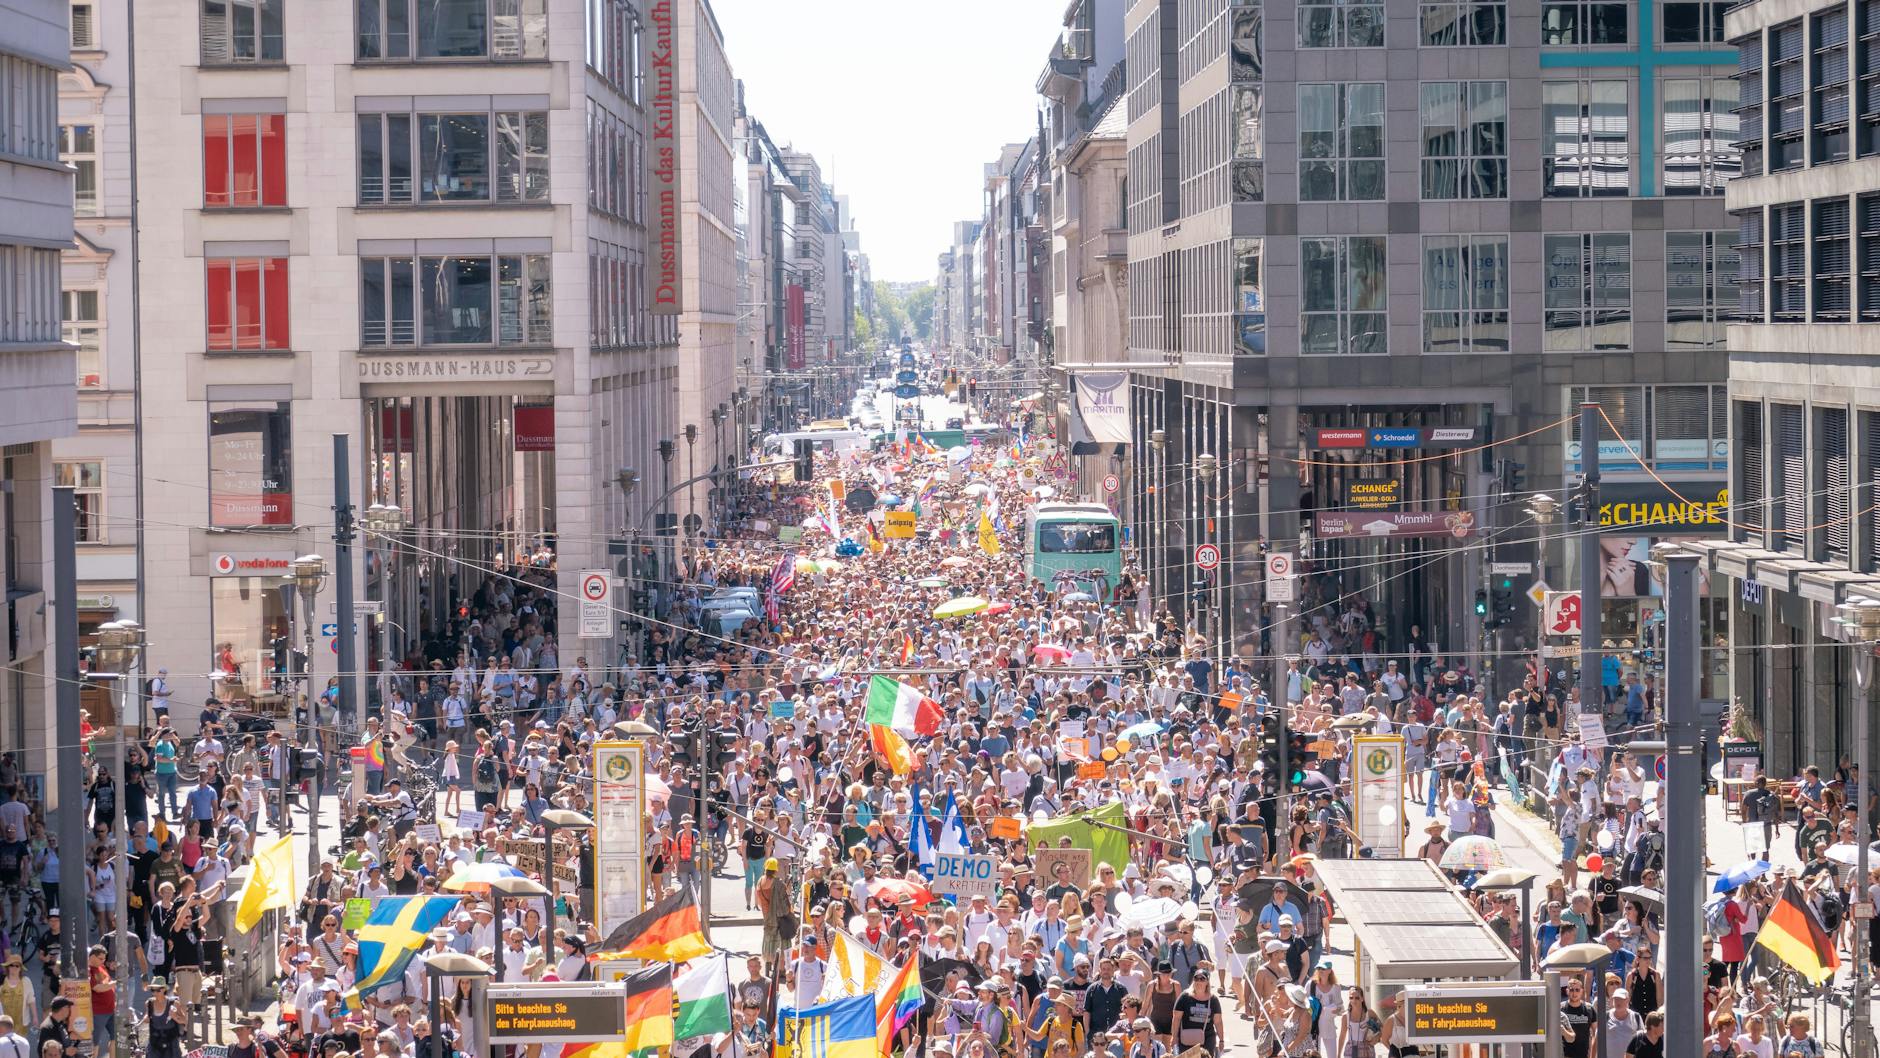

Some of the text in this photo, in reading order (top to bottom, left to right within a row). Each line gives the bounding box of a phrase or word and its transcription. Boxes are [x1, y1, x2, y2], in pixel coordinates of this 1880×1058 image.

[654, 147, 674, 183] das
[656, 190, 676, 305] Dussmann
[359, 360, 517, 377] DUSSMANN-HAUS
[1321, 432, 1363, 440] westermann
[1383, 434, 1416, 442] Schroedel
[1435, 431, 1470, 439] Diesterweg
[263, 480, 278, 489] Uhr
[1106, 479, 1116, 488] 30
[888, 519, 913, 528] Leipzig
[1320, 518, 1344, 526] berlin
[1394, 514, 1433, 525] Mmmh!
[1320, 526, 1344, 534] tapas
[1200, 551, 1215, 563] 30
[237, 559, 289, 569] vodafone
[937, 856, 992, 879] DEMO
[495, 1002, 568, 1015] Bitte beachten Sie
[1415, 1002, 1488, 1015] Bitte beachten Sie
[496, 1017, 576, 1030] den Fahrplanaushang
[1415, 1017, 1496, 1030] den Fahrplanaushang
